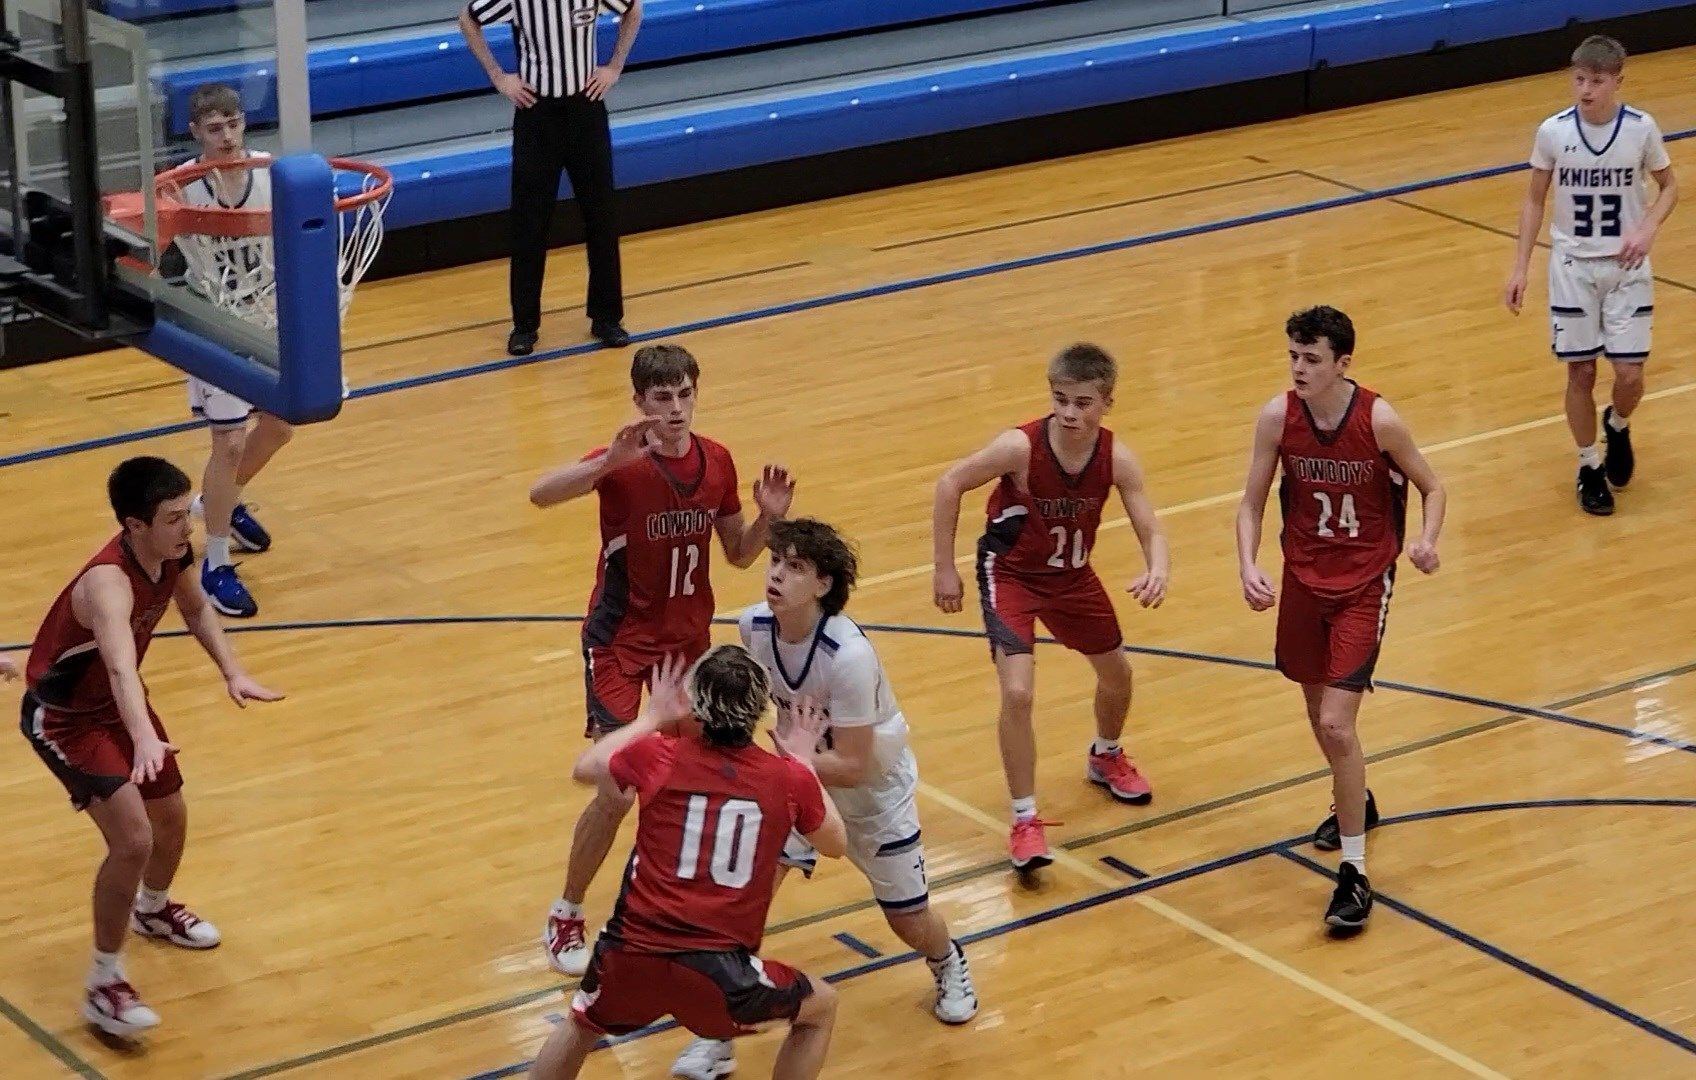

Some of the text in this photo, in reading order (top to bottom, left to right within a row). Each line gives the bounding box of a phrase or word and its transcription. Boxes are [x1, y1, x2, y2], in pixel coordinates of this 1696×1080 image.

[1559, 167, 1634, 187] KNIGHTS
[1572, 194, 1622, 237] 33
[1312, 491, 1360, 538] 24
[669, 544, 699, 598] 12
[677, 794, 763, 889] 10
